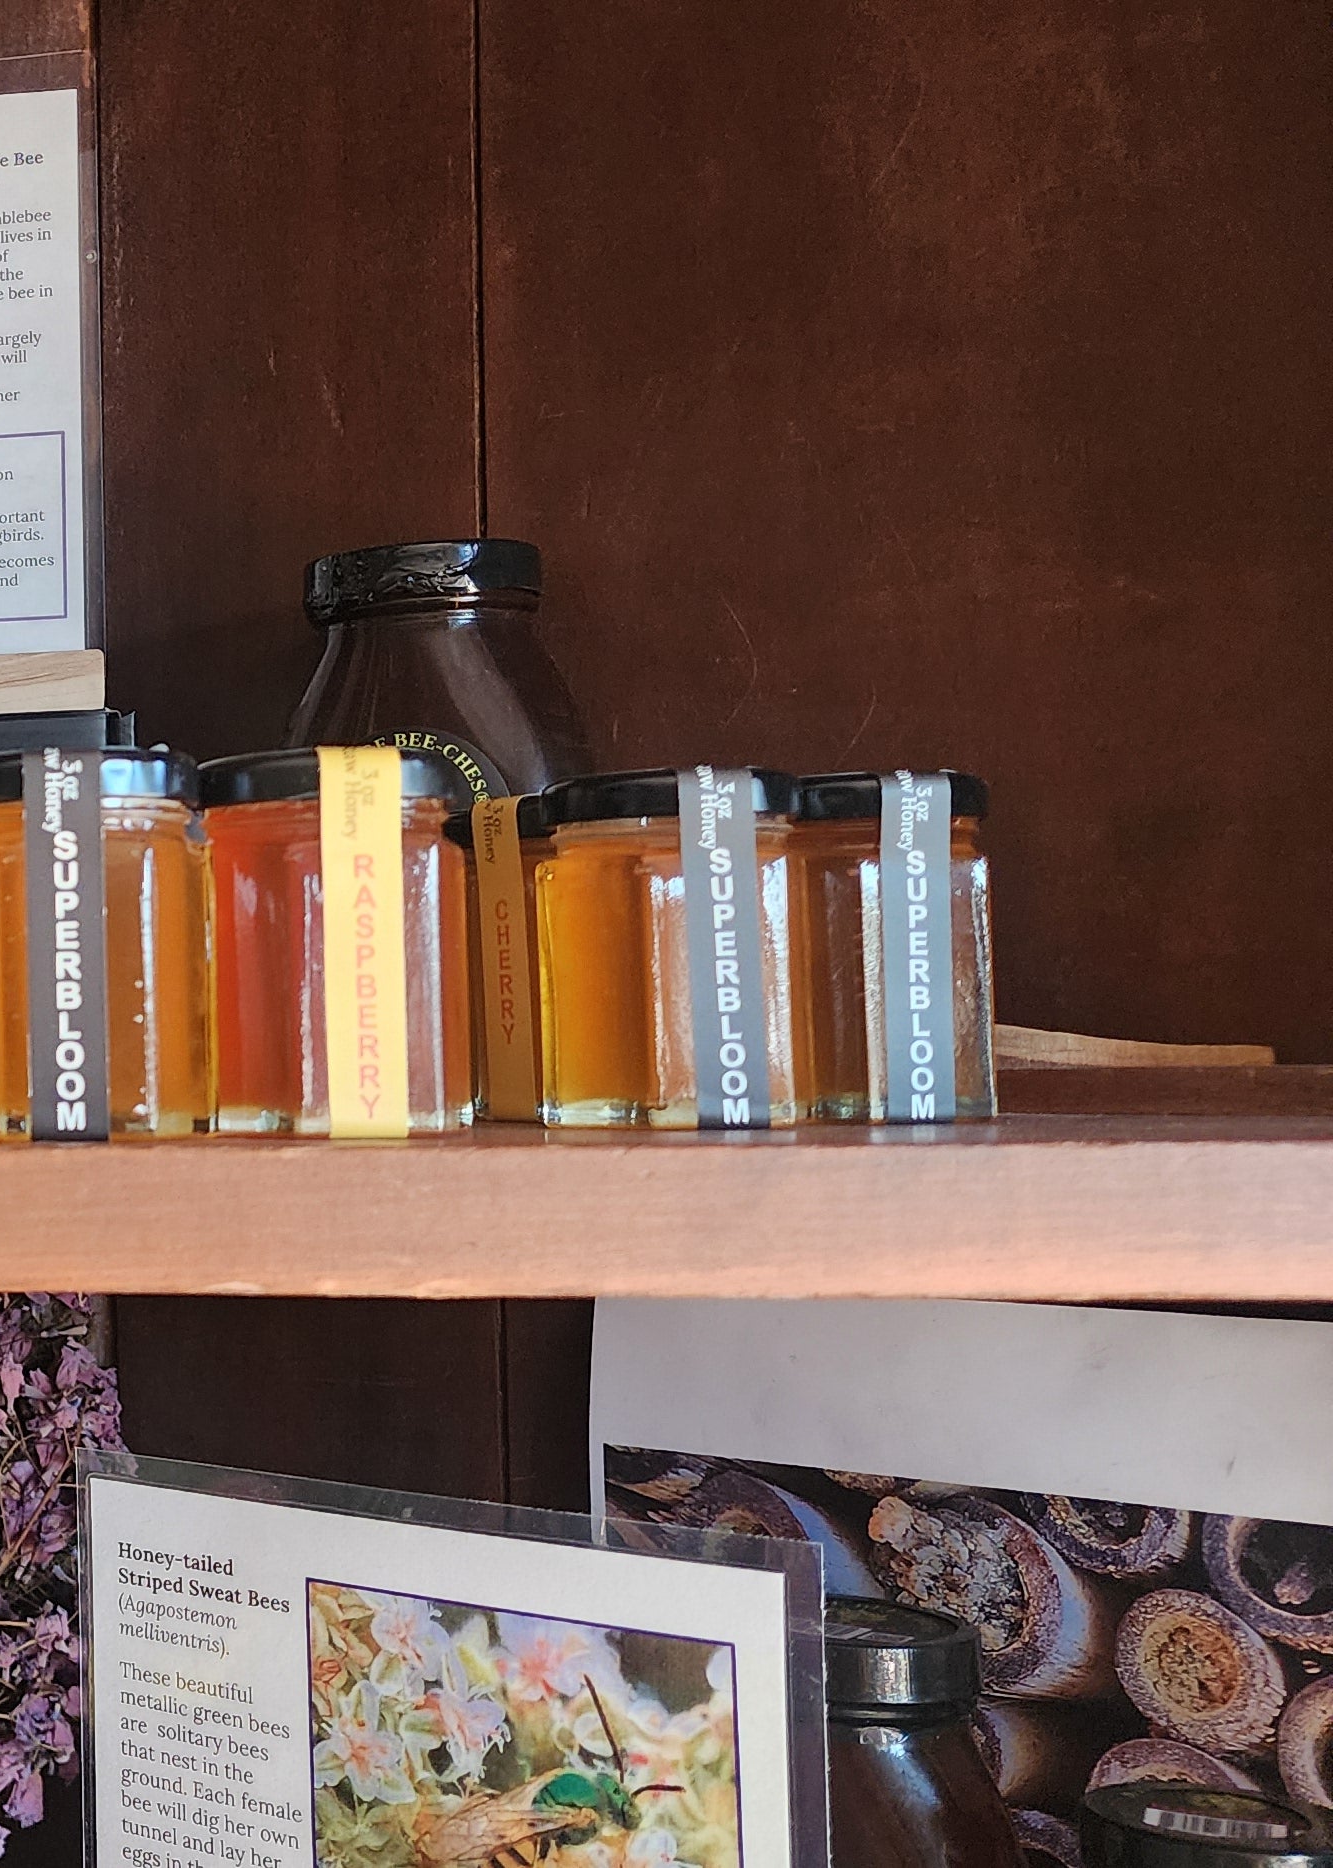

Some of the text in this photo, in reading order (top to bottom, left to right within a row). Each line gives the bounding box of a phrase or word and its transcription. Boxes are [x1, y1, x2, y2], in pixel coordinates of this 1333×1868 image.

[14, 152, 43, 166] Bee
[8, 287, 34, 299] bee
[40, 285, 53, 297] in
[41, 771, 64, 833] Honey
[697, 793, 719, 849] Honey
[716, 797, 732, 819] oz
[896, 796, 917, 851] Honey
[53, 831, 87, 1131] SUPERBLOOM
[351, 855, 382, 1120] RASPBERRY
[494, 901, 515, 1045] CHERRY
[708, 848, 750, 1126] SUPERBLOOM
[904, 850, 936, 1120] SUPERBLOOM
[118, 1542, 233, 1576] Honey-tailed
[119, 1568, 289, 1613] Striped Sweat Bees
[119, 1593, 237, 1630] (Agapostemon
[119, 1622, 229, 1659] melliventris).
[119, 1661, 253, 1704] These beautiful
[121, 1692, 290, 1739] metallic green bees
[121, 1717, 268, 1761] are solitary bees
[121, 1739, 253, 1784] that nest in the
[121, 1769, 302, 1823] ground. Each female
[121, 1789, 299, 1849] bee will dig her own
[122, 1818, 282, 1868] tunnel and lay her
[123, 1846, 161, 1868] eggs
